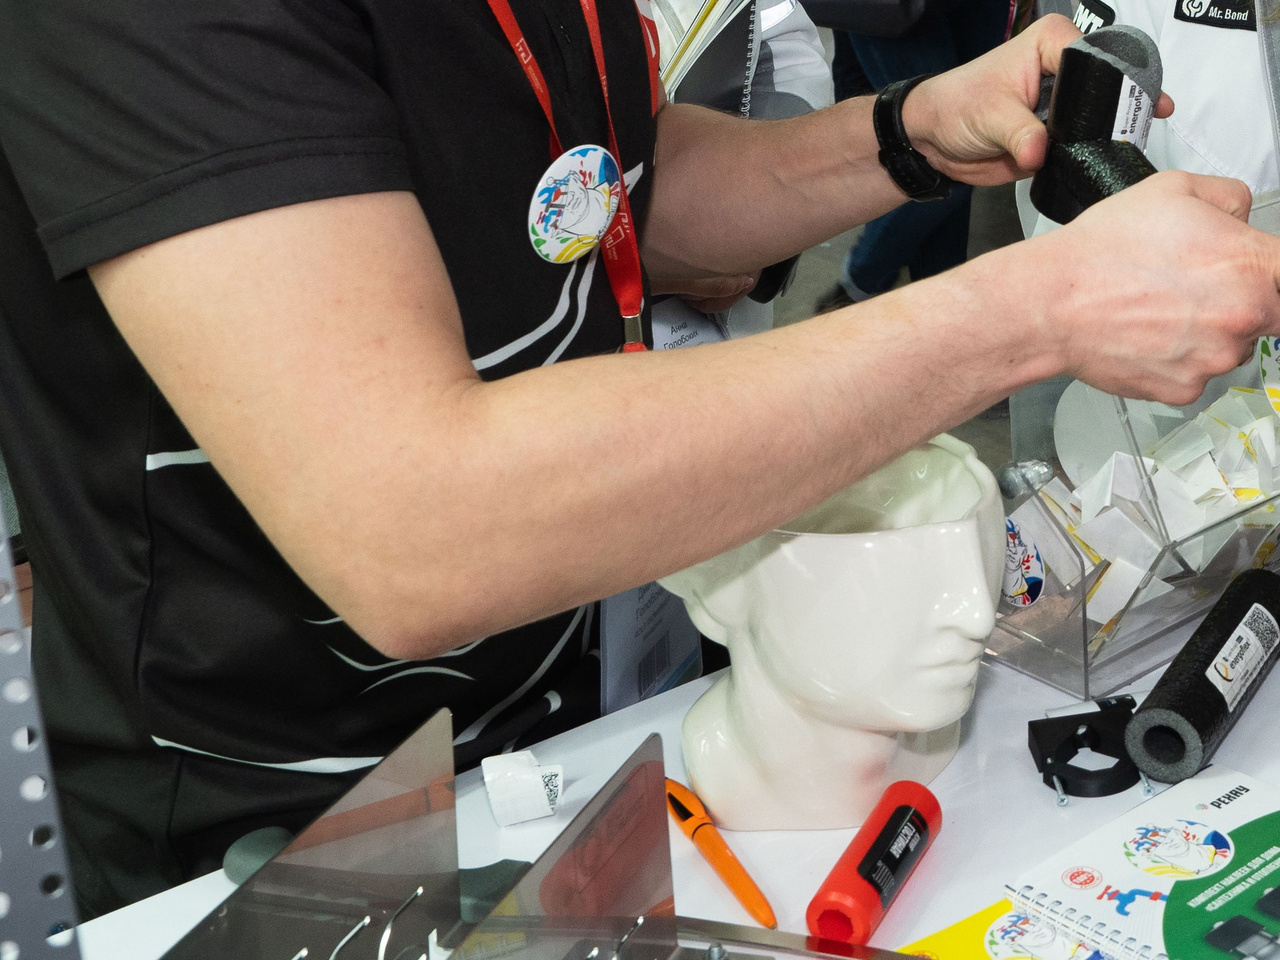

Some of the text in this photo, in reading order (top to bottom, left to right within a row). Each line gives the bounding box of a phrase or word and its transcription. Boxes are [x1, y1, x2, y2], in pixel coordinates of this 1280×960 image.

[1208, 6, 1249, 21] Mr. Bond
[670, 321, 688, 335] Анна
[1229, 641, 1251, 669] energoflex
